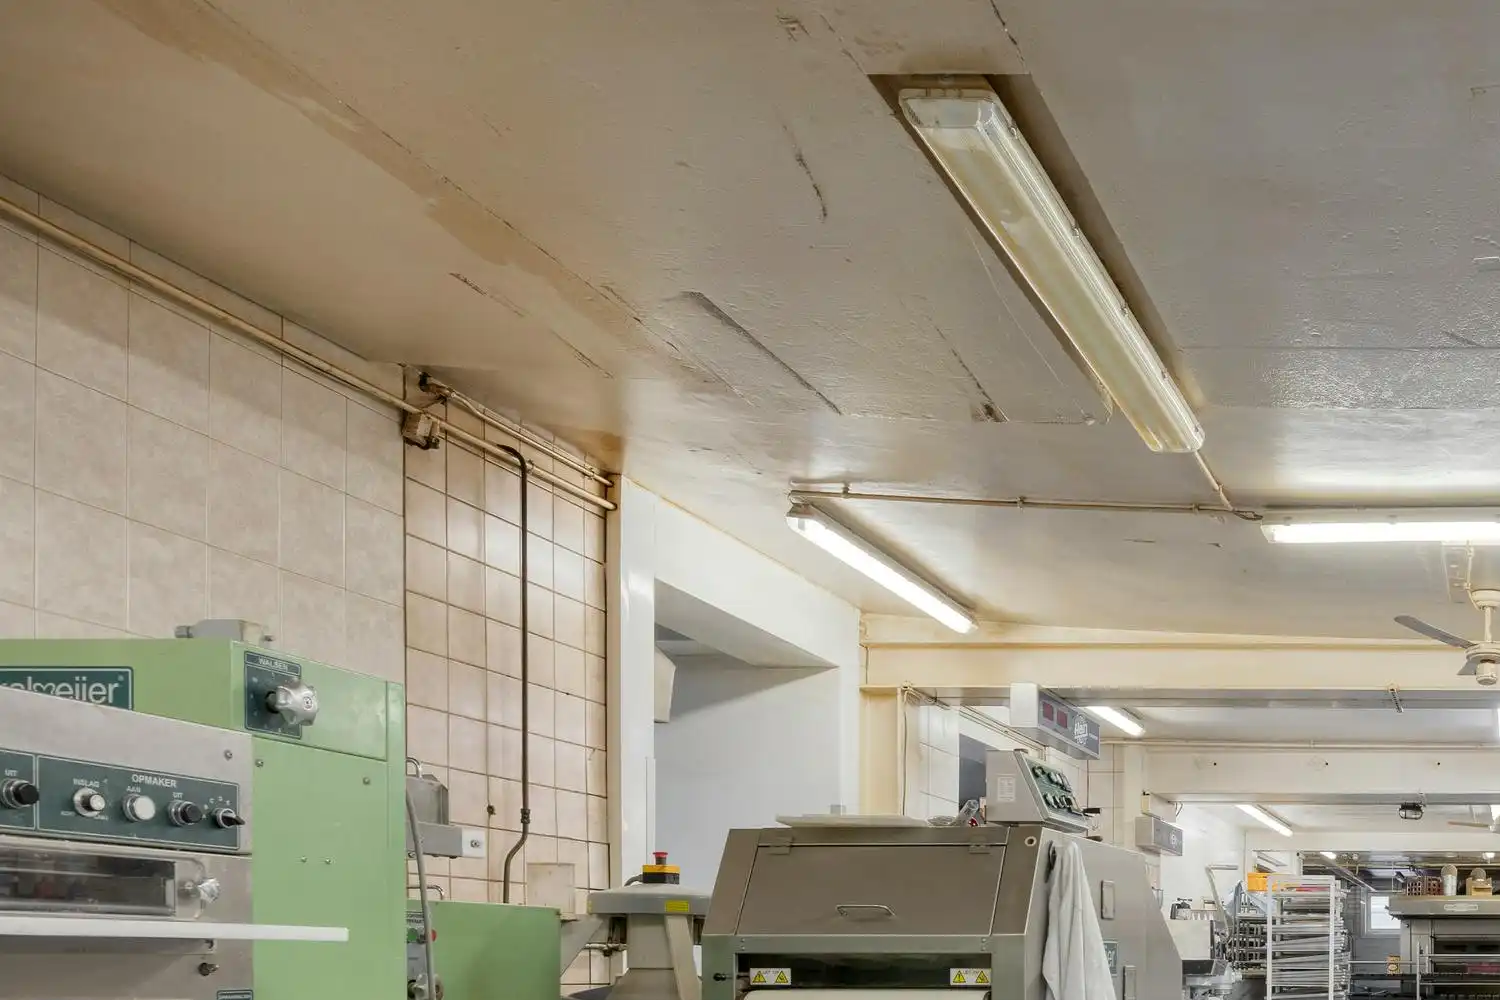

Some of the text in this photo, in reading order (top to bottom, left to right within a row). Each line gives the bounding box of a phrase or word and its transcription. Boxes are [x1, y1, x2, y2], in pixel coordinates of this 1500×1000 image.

[4, 768, 18, 777] UIT
[73, 778, 100, 789] INSLAG
[131, 774, 177, 788] OPMAKER
[126, 785, 141, 793] AAN
